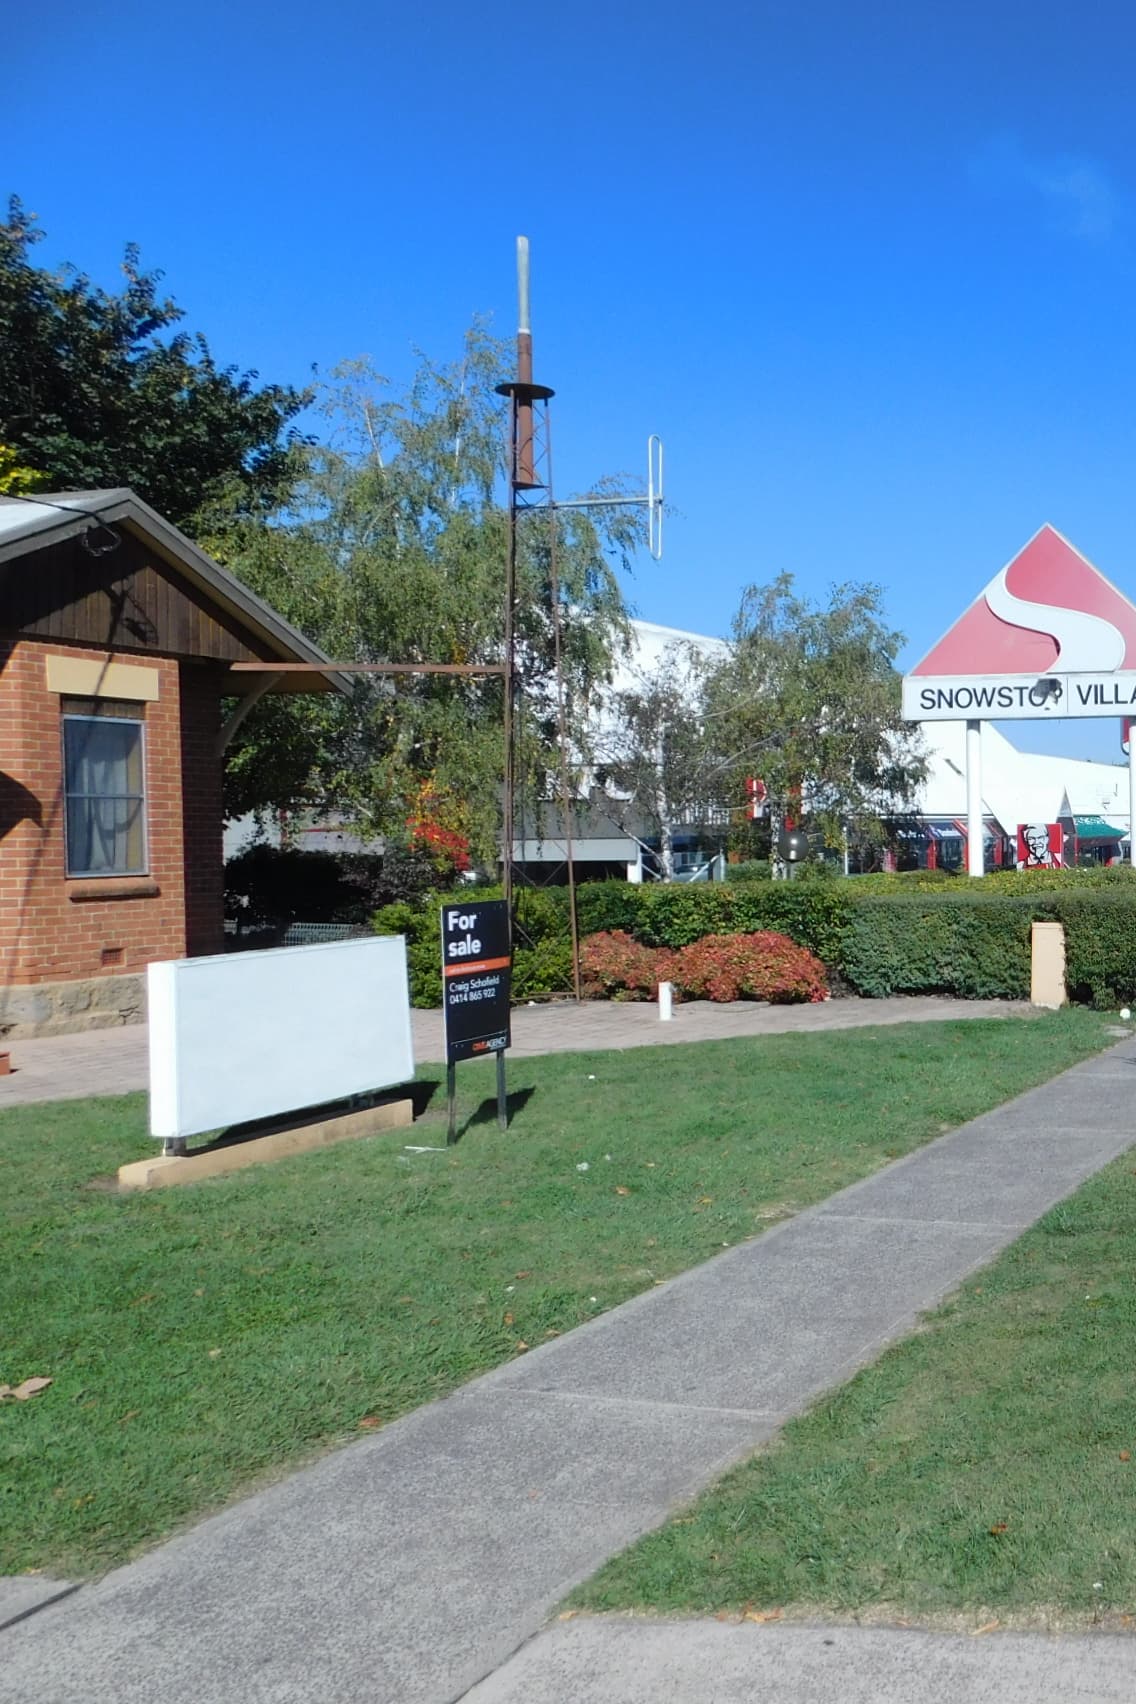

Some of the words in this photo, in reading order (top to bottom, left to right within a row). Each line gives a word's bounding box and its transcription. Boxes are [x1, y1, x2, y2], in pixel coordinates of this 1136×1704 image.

[448, 911, 477, 932] For
[448, 933, 482, 957] sale
[449, 981, 470, 993] Craig
[470, 974, 500, 989] Schofield
[449, 992, 468, 1004] 0414
[469, 989, 483, 1001] 865
[483, 987, 496, 998] 922
